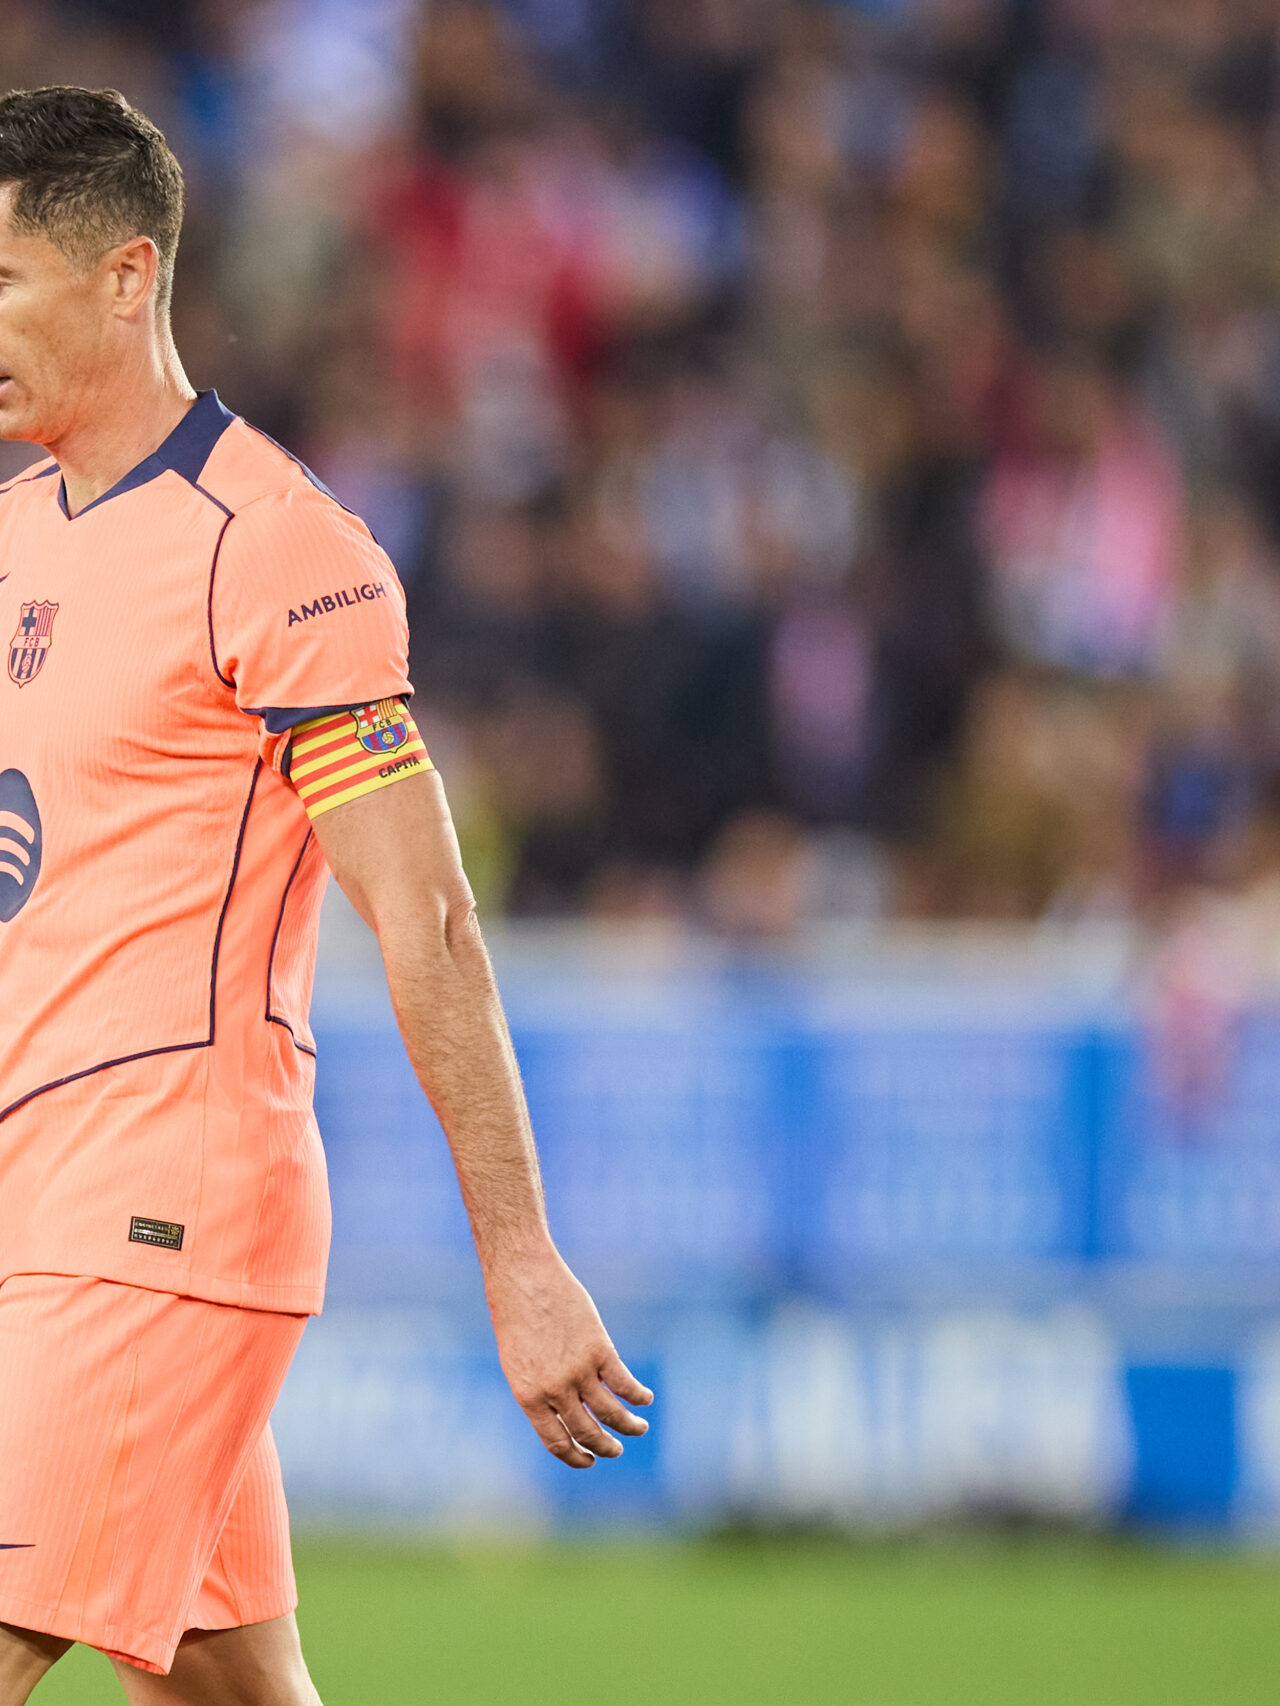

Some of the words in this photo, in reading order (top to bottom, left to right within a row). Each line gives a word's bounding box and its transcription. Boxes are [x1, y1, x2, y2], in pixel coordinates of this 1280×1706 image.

[287, 581, 389, 628] AMBILIGH
[23, 637, 40, 647] FCB
[372, 718, 392, 731] FCB
